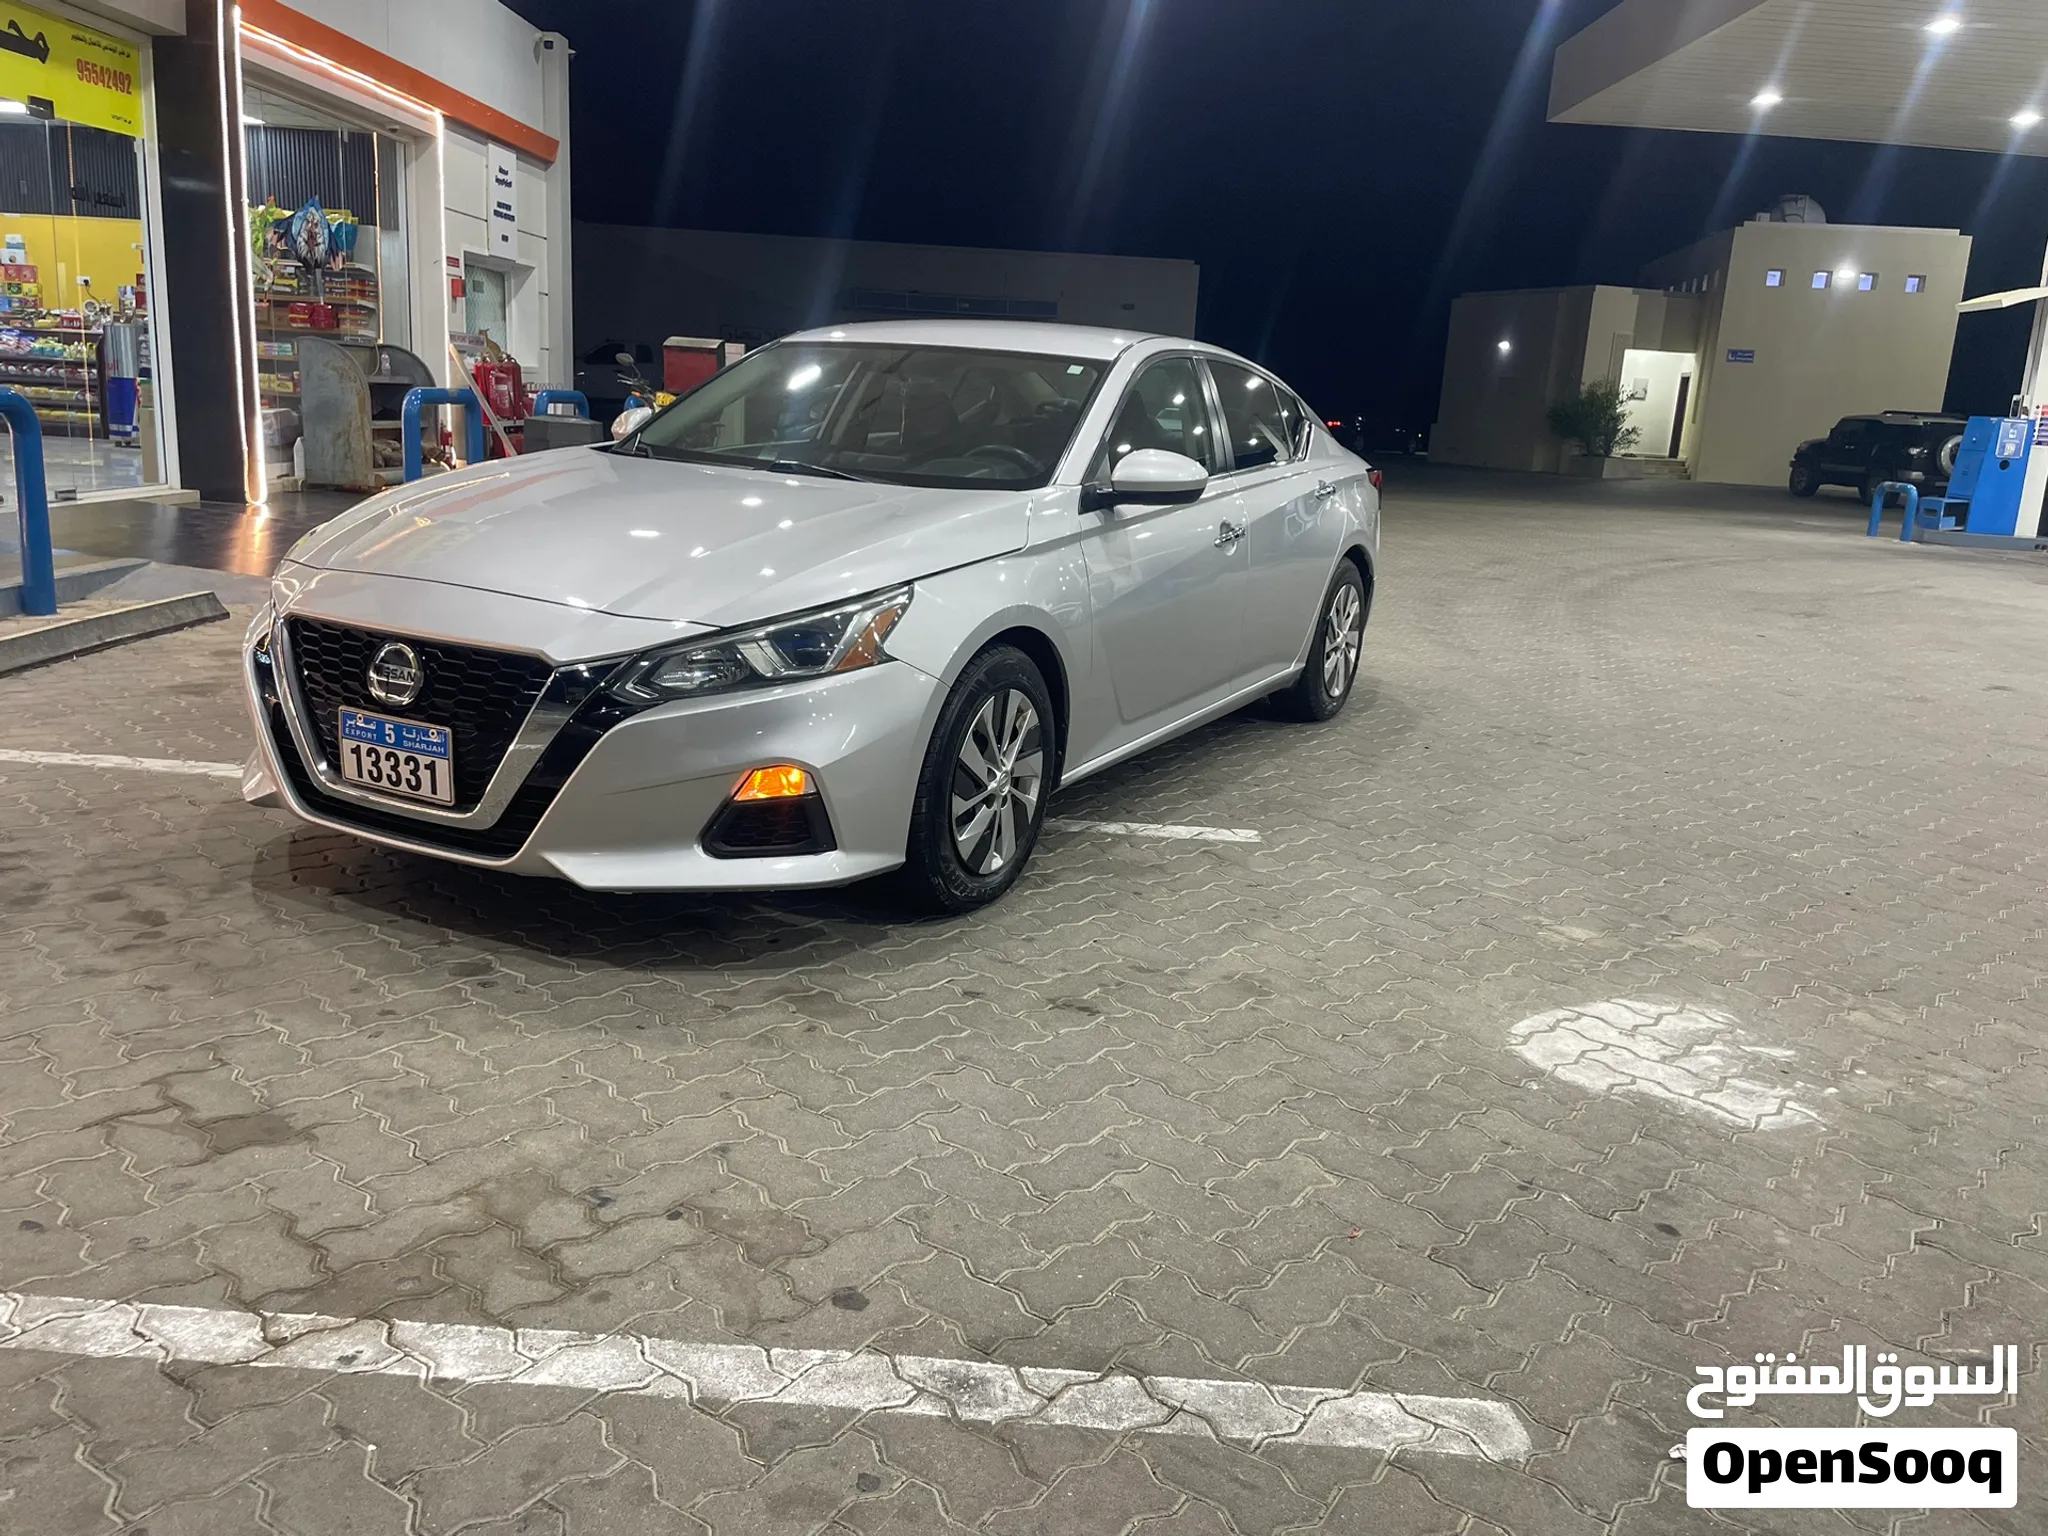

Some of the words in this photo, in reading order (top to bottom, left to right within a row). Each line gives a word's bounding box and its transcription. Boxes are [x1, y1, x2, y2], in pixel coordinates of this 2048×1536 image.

[76, 58, 132, 95] 95542492
[345, 728, 378, 740] EXPORT
[384, 723, 396, 744] 5
[402, 740, 445, 754] SHARJAH
[350, 744, 438, 796] 13331
